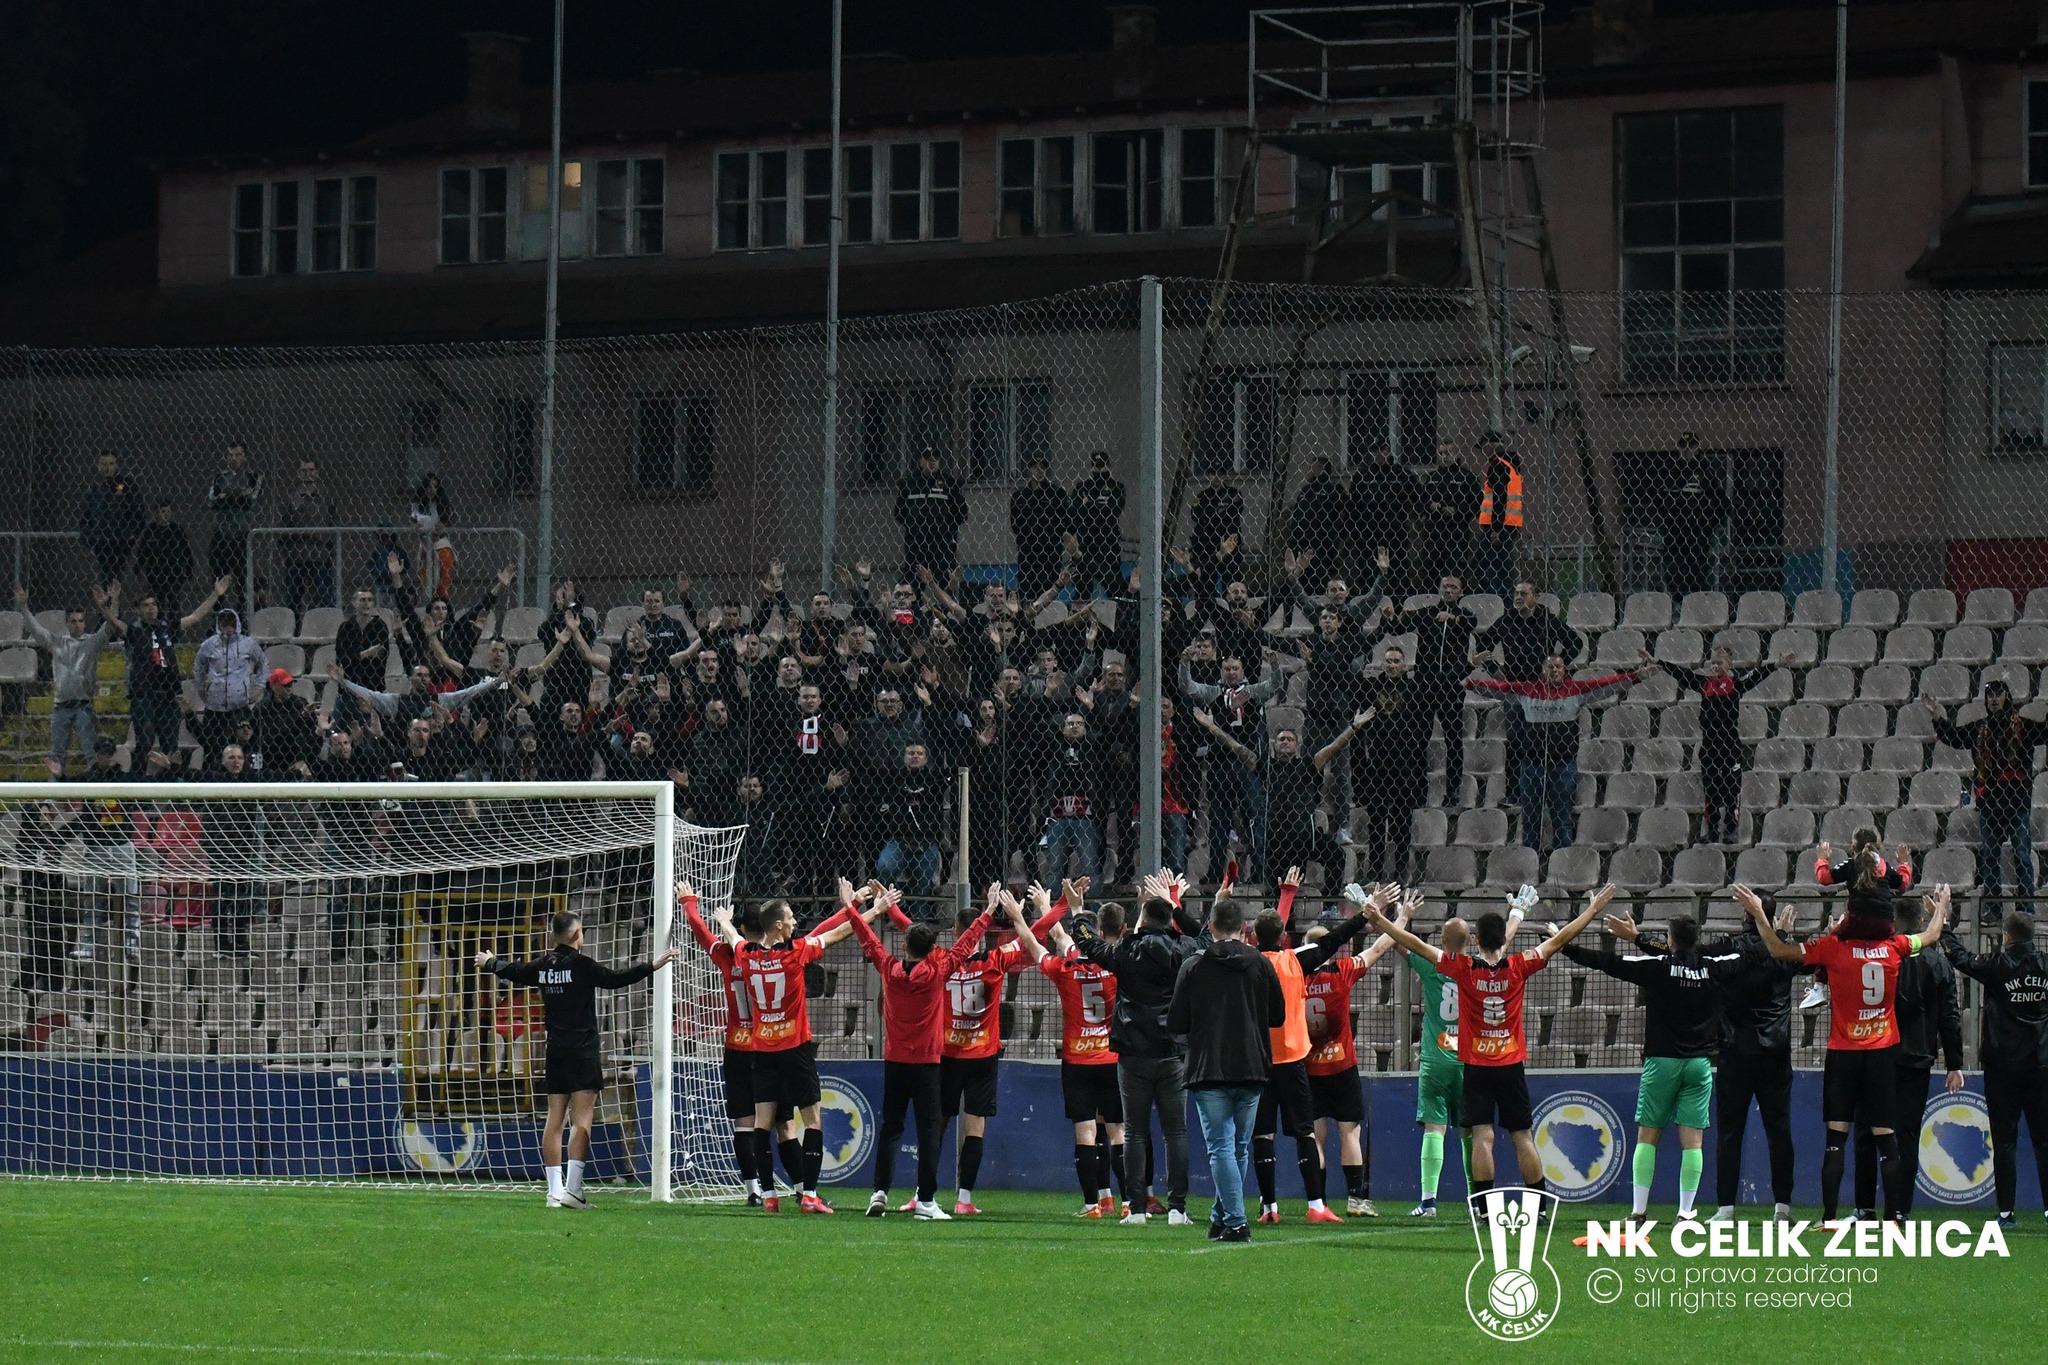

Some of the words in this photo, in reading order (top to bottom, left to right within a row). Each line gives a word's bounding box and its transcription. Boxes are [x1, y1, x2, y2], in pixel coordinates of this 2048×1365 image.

[547, 969, 573, 984] ČELIK
[750, 972, 786, 1010] 17
[1861, 962, 1885, 1006] 9
[2004, 978, 2022, 992] NK
[946, 980, 986, 1017] 18
[1081, 983, 1106, 1024] 5
[1482, 996, 1506, 1027] 8
[2010, 992, 2047, 1002] ZENICA
